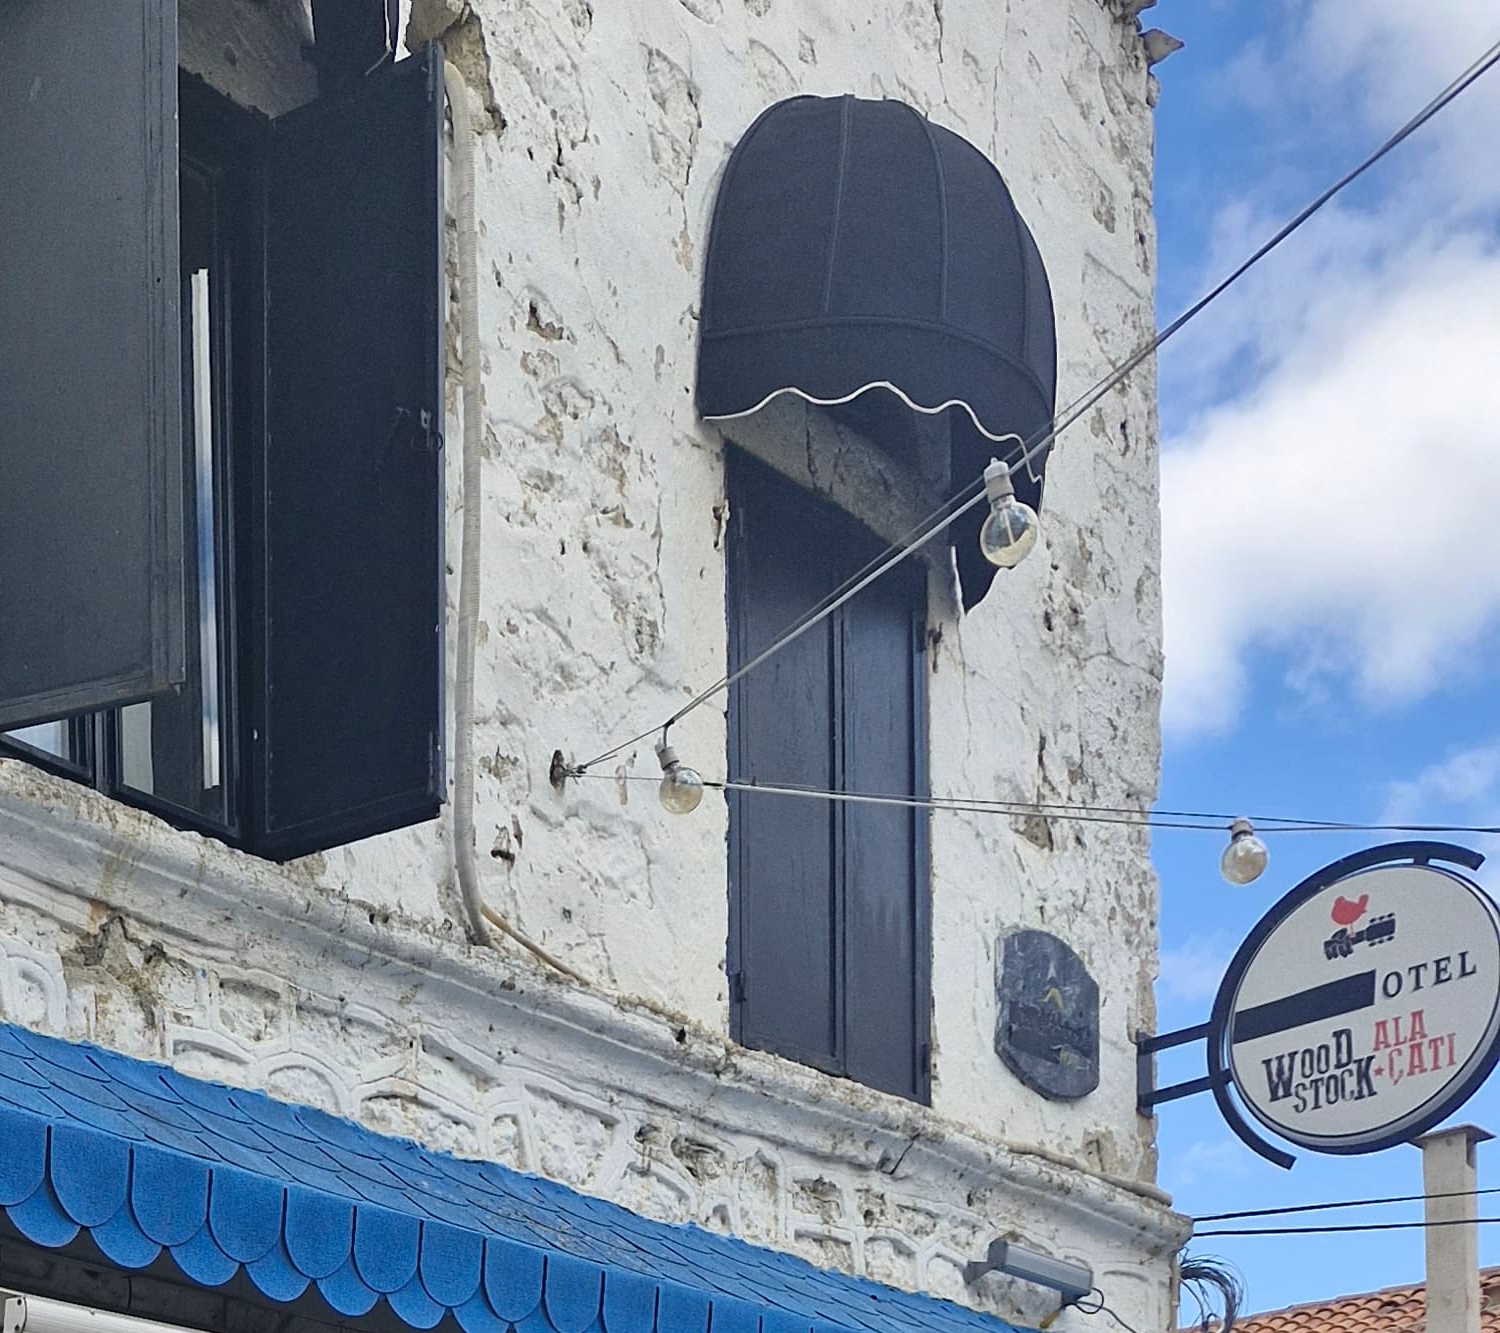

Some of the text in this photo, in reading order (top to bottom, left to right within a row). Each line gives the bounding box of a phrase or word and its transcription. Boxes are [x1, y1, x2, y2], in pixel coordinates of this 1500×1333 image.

[1382, 951, 1477, 998] OTEL
[1373, 1009, 1428, 1051] ALA
[1292, 1055, 1377, 1113] STOCK
